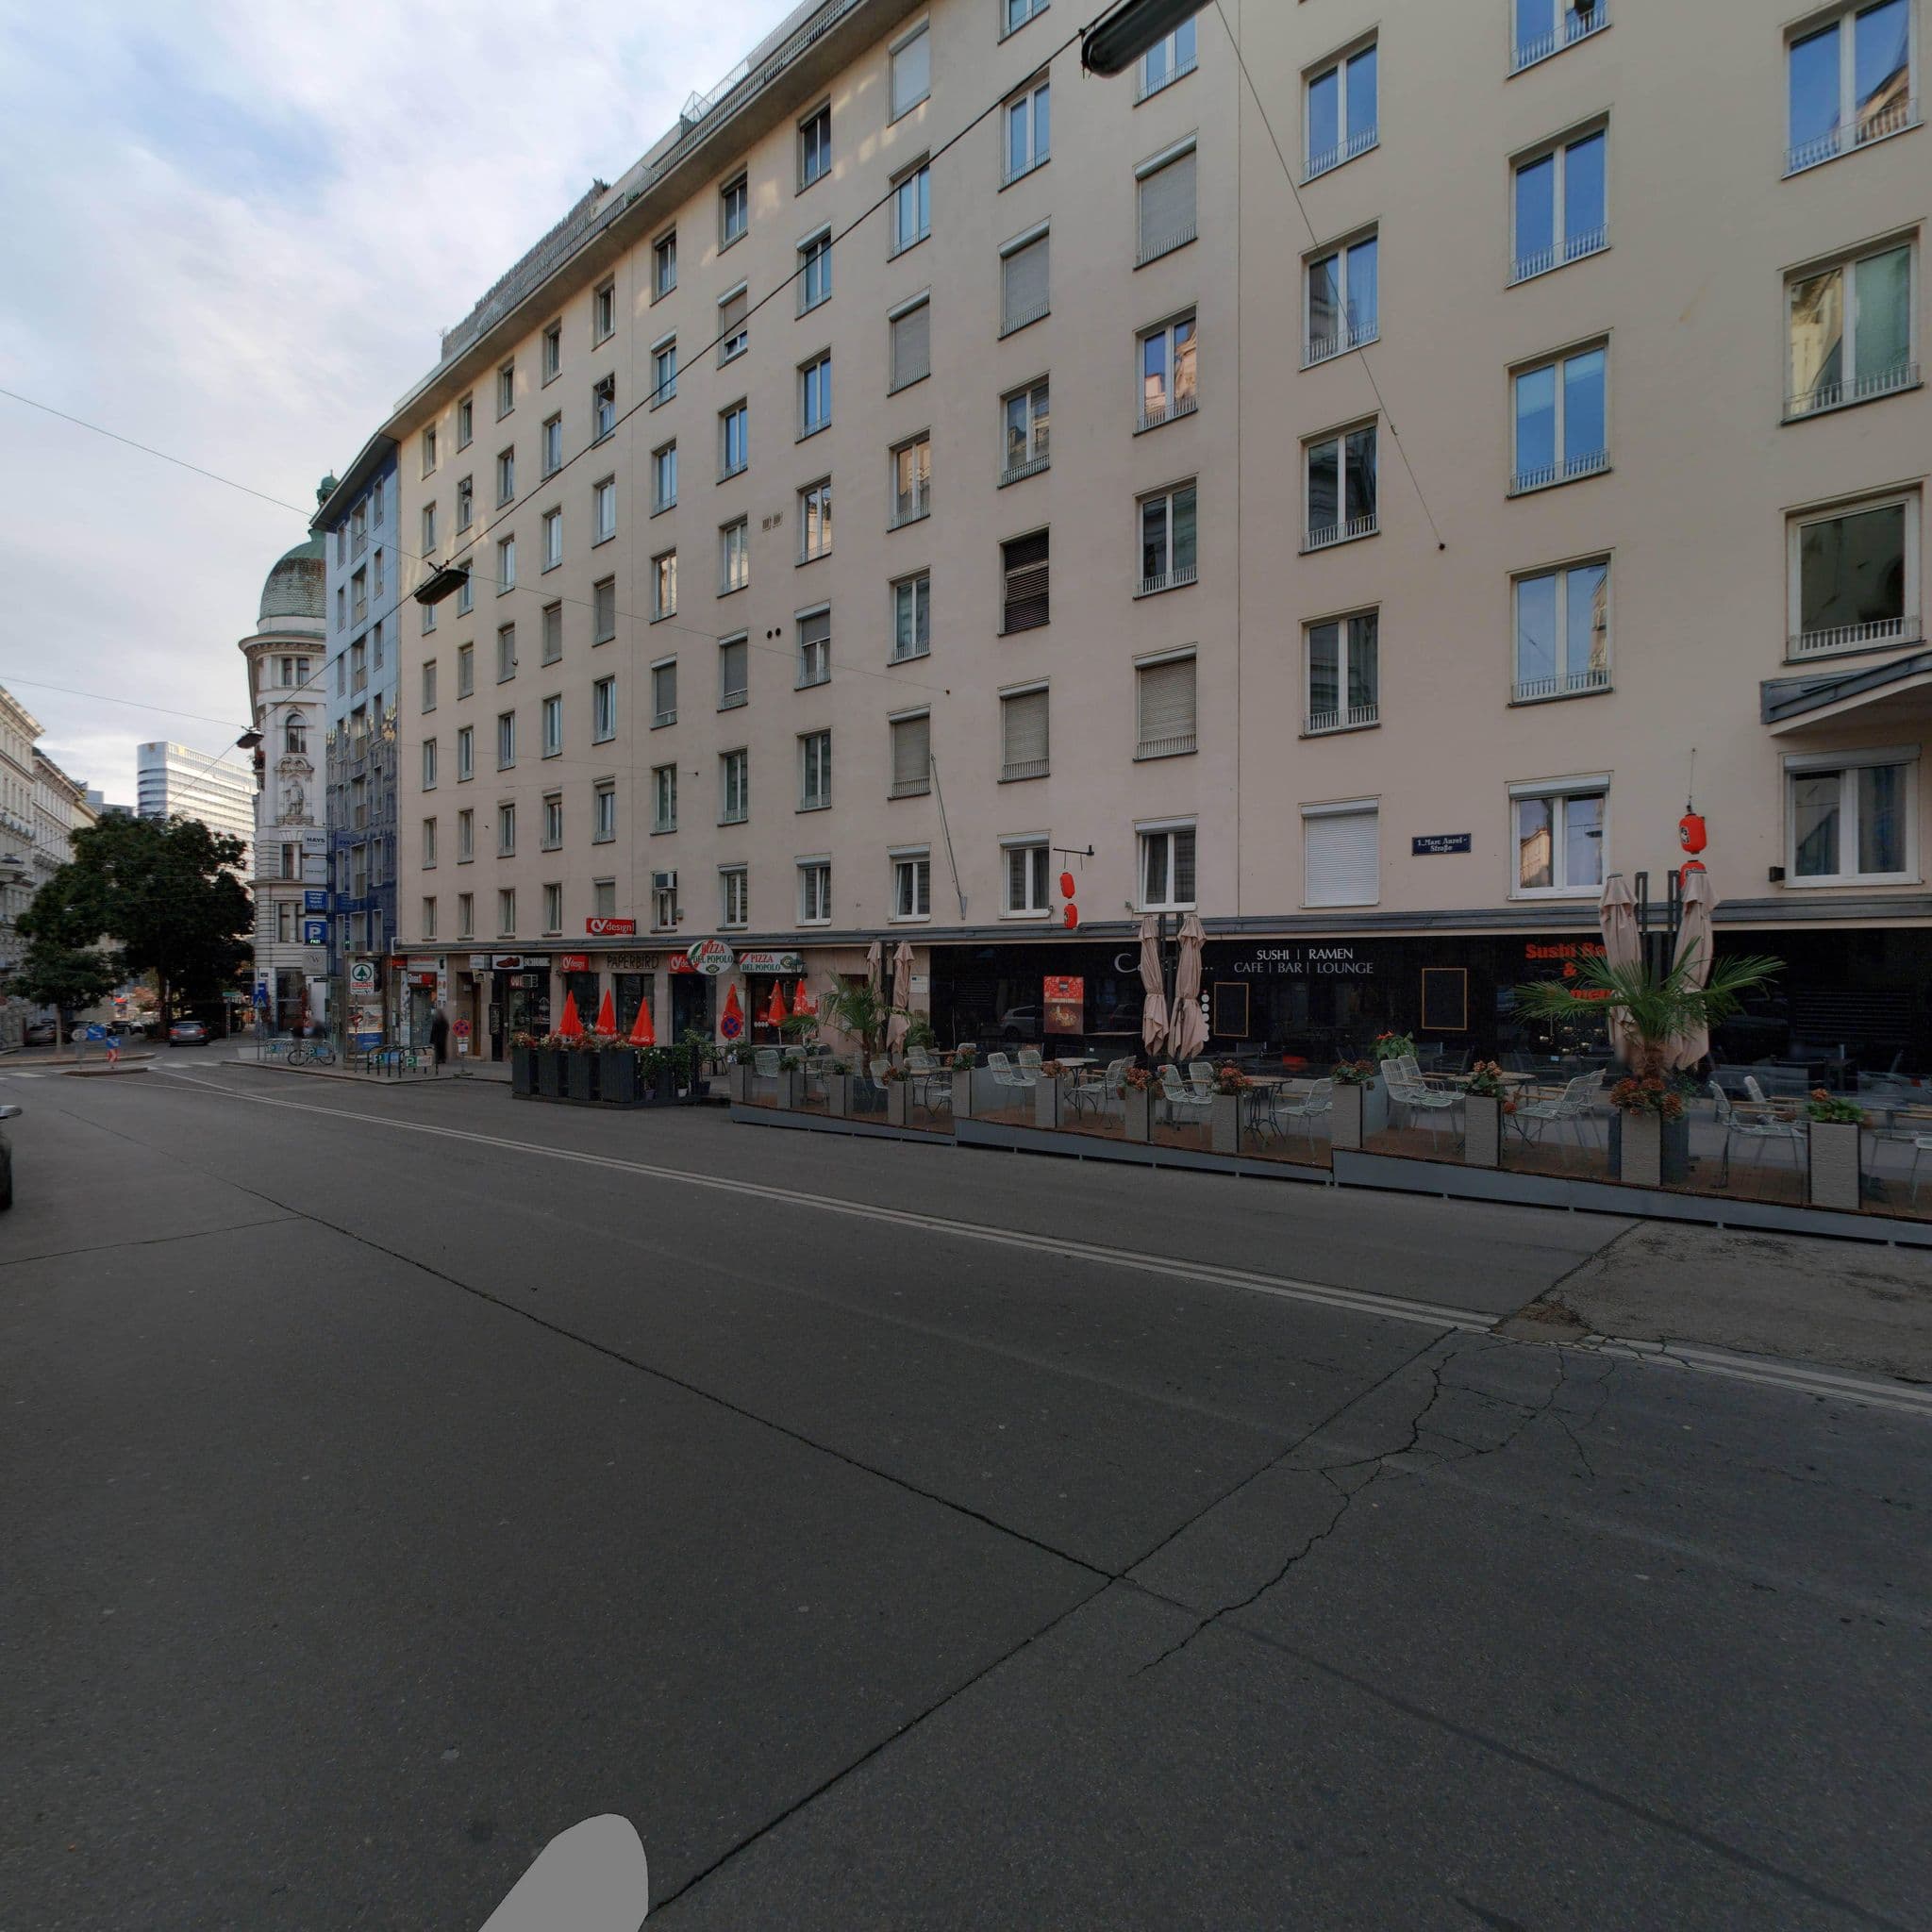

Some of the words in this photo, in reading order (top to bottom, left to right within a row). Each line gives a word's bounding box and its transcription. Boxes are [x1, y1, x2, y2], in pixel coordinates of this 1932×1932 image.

[1424, 838, 1441, 846] Marc
[701, 942, 725, 954] PIZZA
[1257, 949, 1290, 960] SUSHI
[1308, 947, 1354, 959] RAMEN
[1524, 943, 1576, 959] Sushi
[607, 953, 659, 969] PAPERBIRD
[707, 955, 733, 964] POPOLO
[750, 954, 774, 963] PIZZA
[755, 963, 781, 972] POPOLO
[1233, 961, 1264, 973] CAFE
[1277, 961, 1303, 974] BAR
[1317, 962, 1374, 974] LOUNGE
[1562, 961, 1576, 976] &
